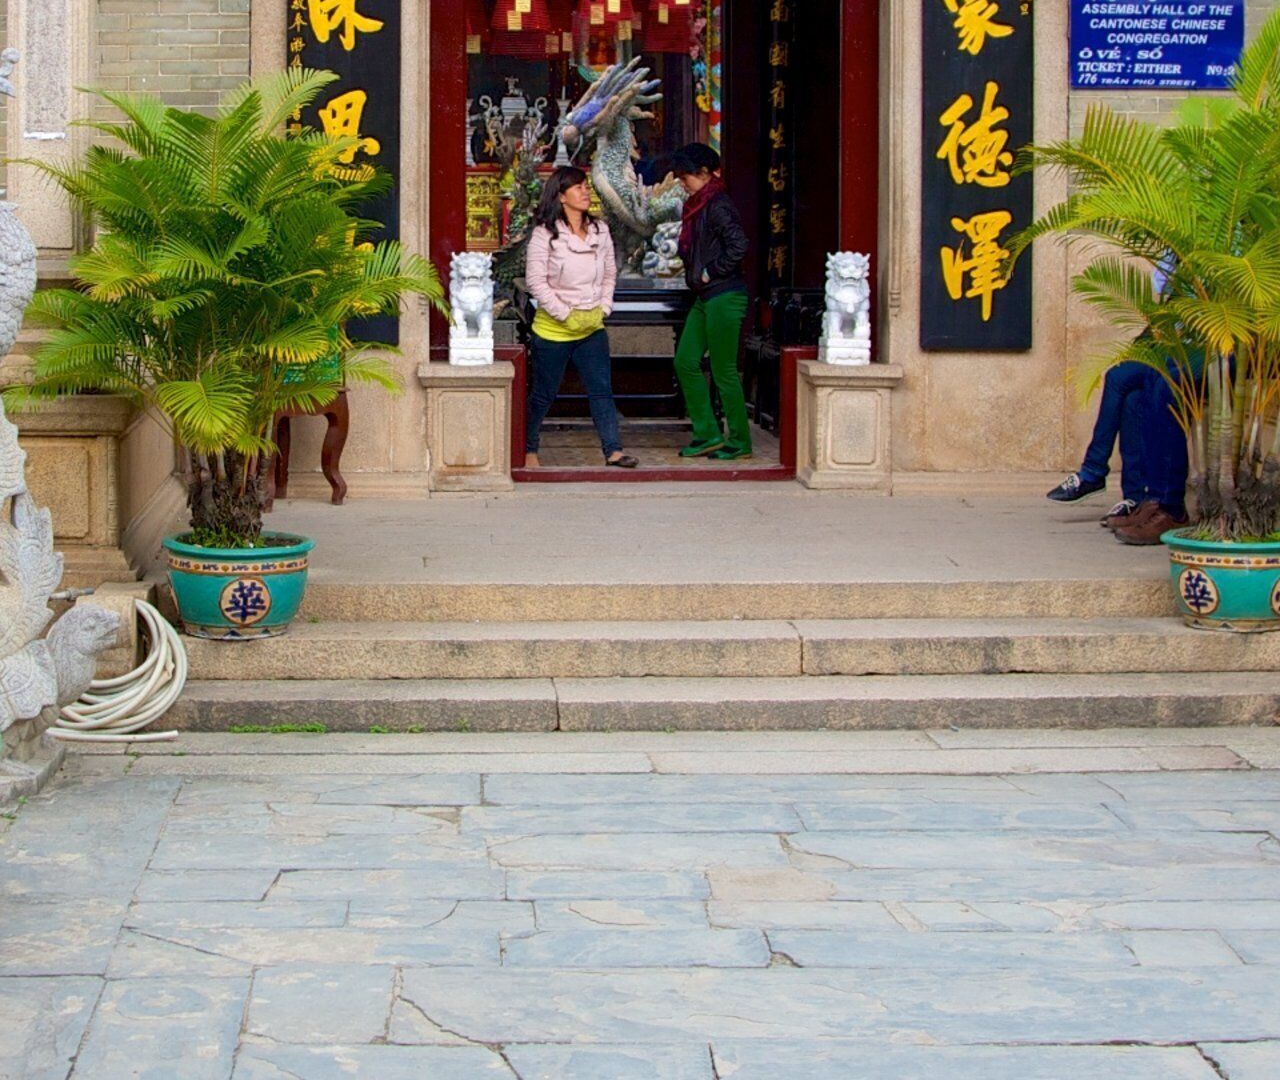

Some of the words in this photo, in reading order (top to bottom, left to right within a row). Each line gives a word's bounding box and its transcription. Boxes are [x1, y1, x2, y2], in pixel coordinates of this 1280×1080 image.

[1082, 4, 1150, 15] ASSEMBLY
[1152, 4, 1184, 15] HALL
[1188, 5, 1206, 15] OF
[1209, 5, 1233, 16] THE
[1090, 18, 1167, 30] CANTONESE
[1172, 19, 1226, 30] CHINESE
[1107, 33, 1208, 44] CONGREGATION
[1097, 46, 1121, 60] VÉ
[1133, 63, 1182, 74] EITHER
[1078, 73, 1097, 84] 176
